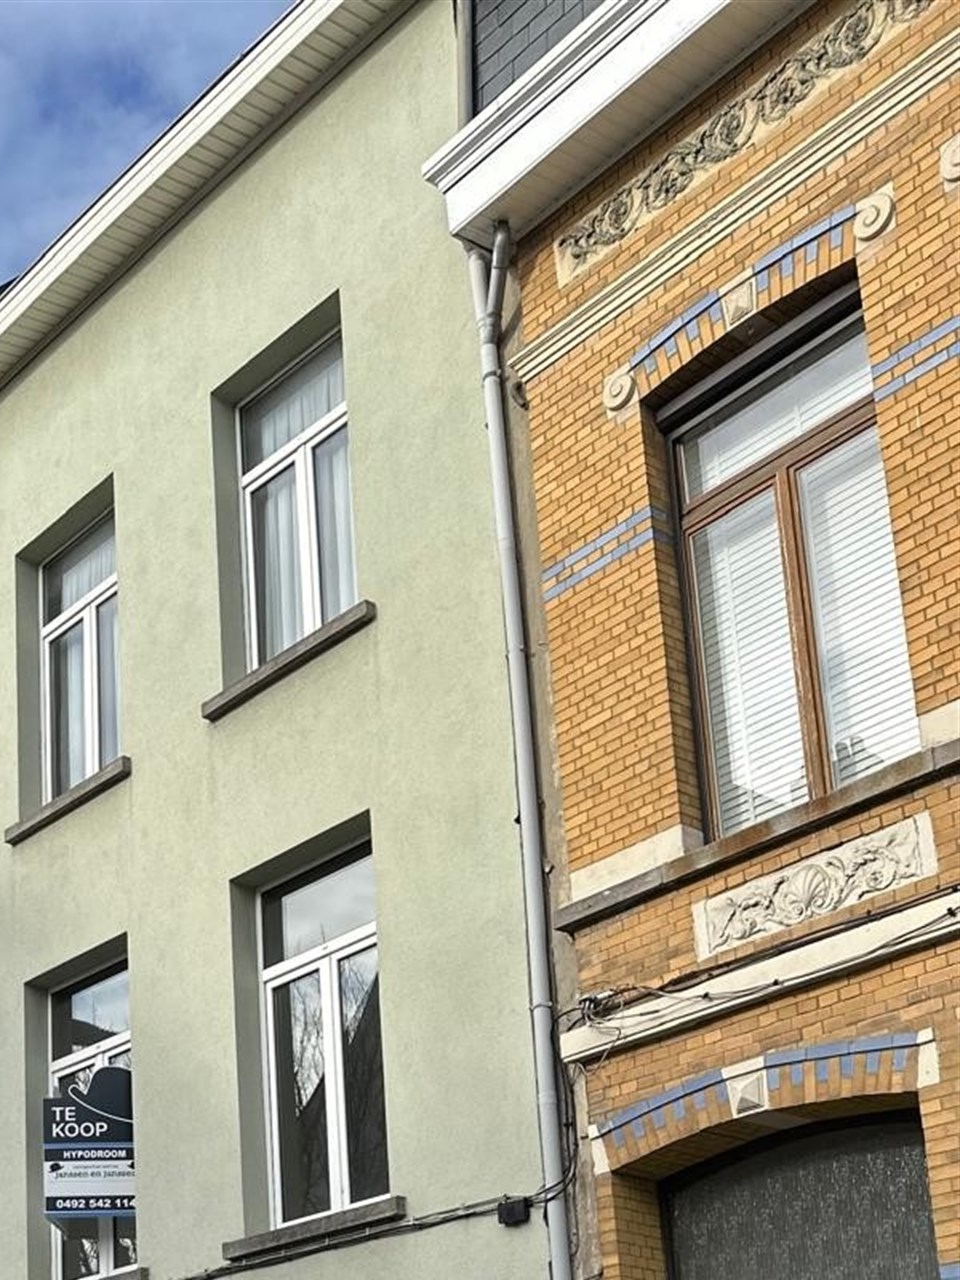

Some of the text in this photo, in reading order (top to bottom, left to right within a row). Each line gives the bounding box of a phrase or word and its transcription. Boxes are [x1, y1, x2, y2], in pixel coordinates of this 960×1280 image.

[51, 1106, 77, 1121] TE
[51, 1122, 109, 1138] KOOP
[63, 1149, 127, 1159] HYPODROOM
[56, 1198, 86, 1208] 0492
[89, 1198, 112, 1208] 542
